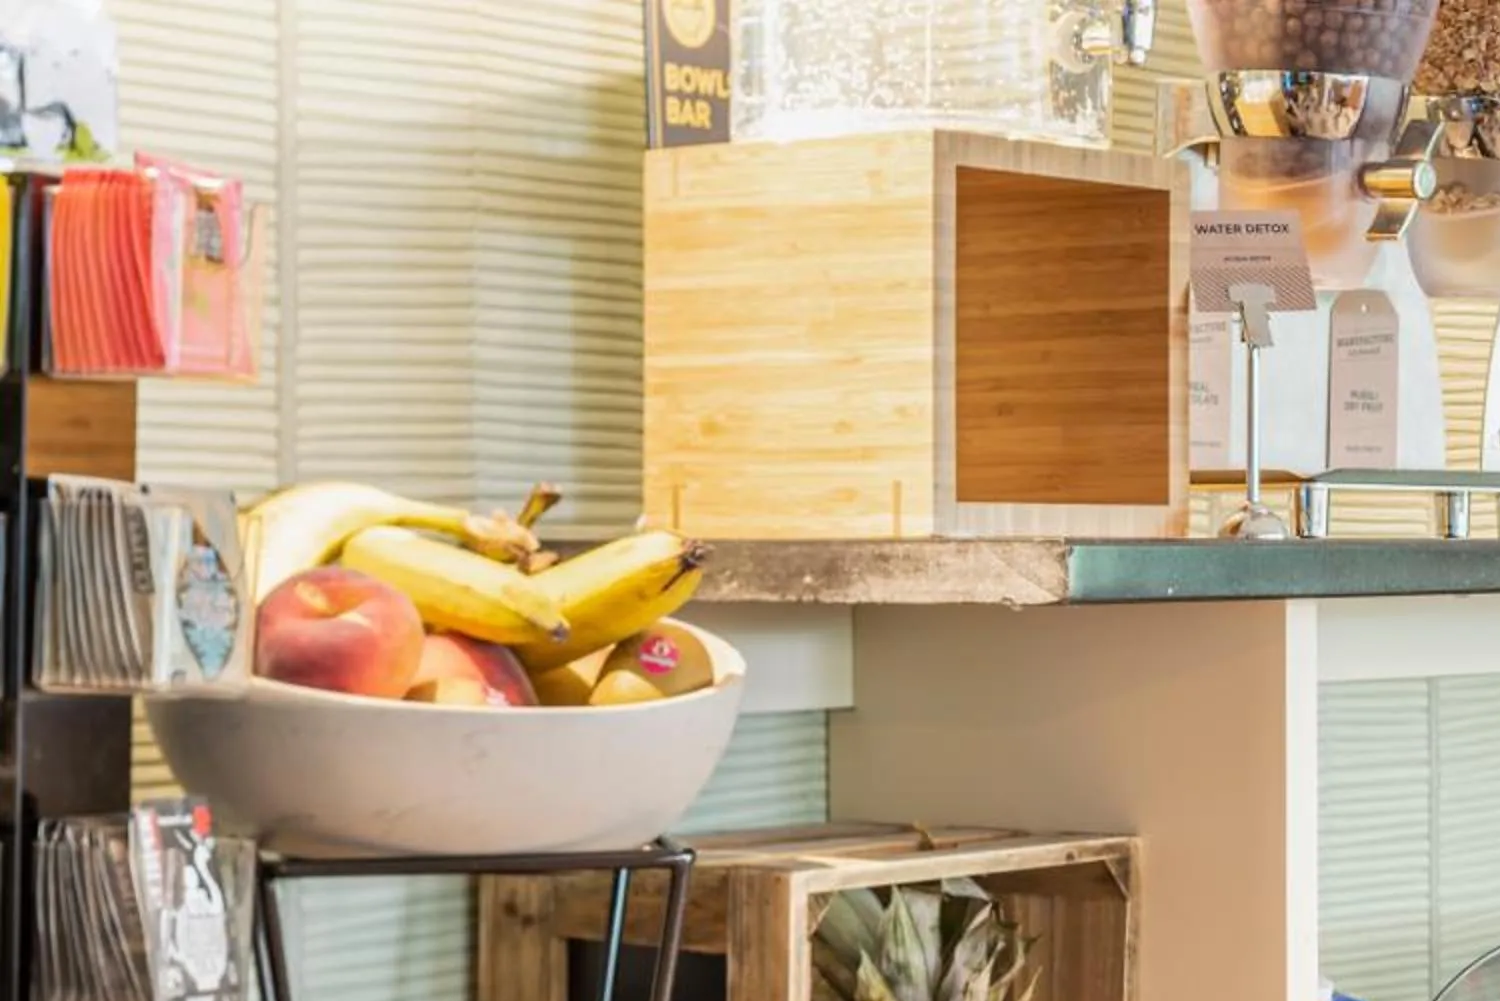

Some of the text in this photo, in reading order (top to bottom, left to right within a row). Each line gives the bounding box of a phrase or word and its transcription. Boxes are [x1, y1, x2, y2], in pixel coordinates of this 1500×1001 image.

[664, 61, 731, 99] BOWL
[665, 95, 712, 129] BAR
[1194, 223, 1290, 235] WATER DETOX
